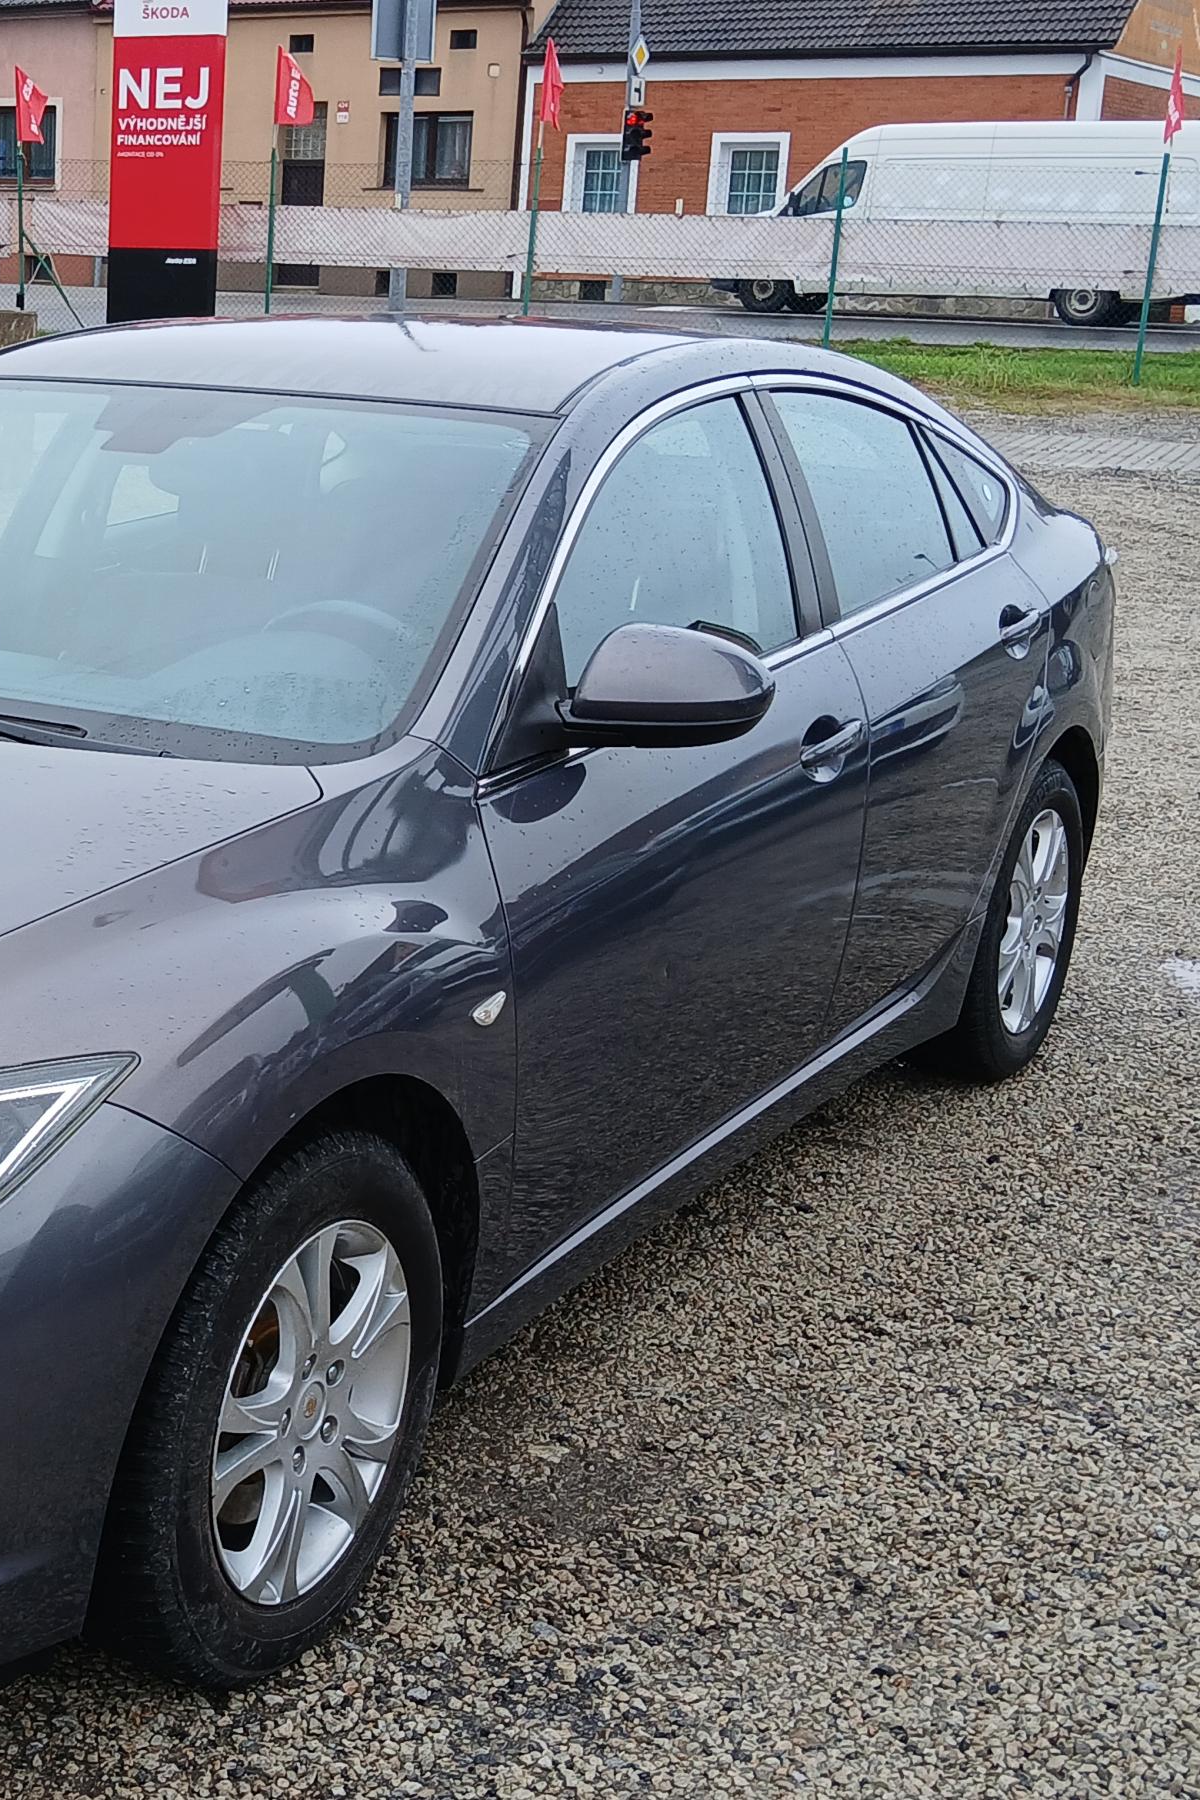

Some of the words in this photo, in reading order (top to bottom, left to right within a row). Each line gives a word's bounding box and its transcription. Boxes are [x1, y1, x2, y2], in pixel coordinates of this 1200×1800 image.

[142, 5, 190, 19] ŠKODA
[118, 67, 210, 110] NEJ
[286, 79, 300, 119] Auto
[117, 114, 207, 131] VÝHODNĚJŠÍ
[116, 131, 201, 146] FINANCOVÁNÍ
